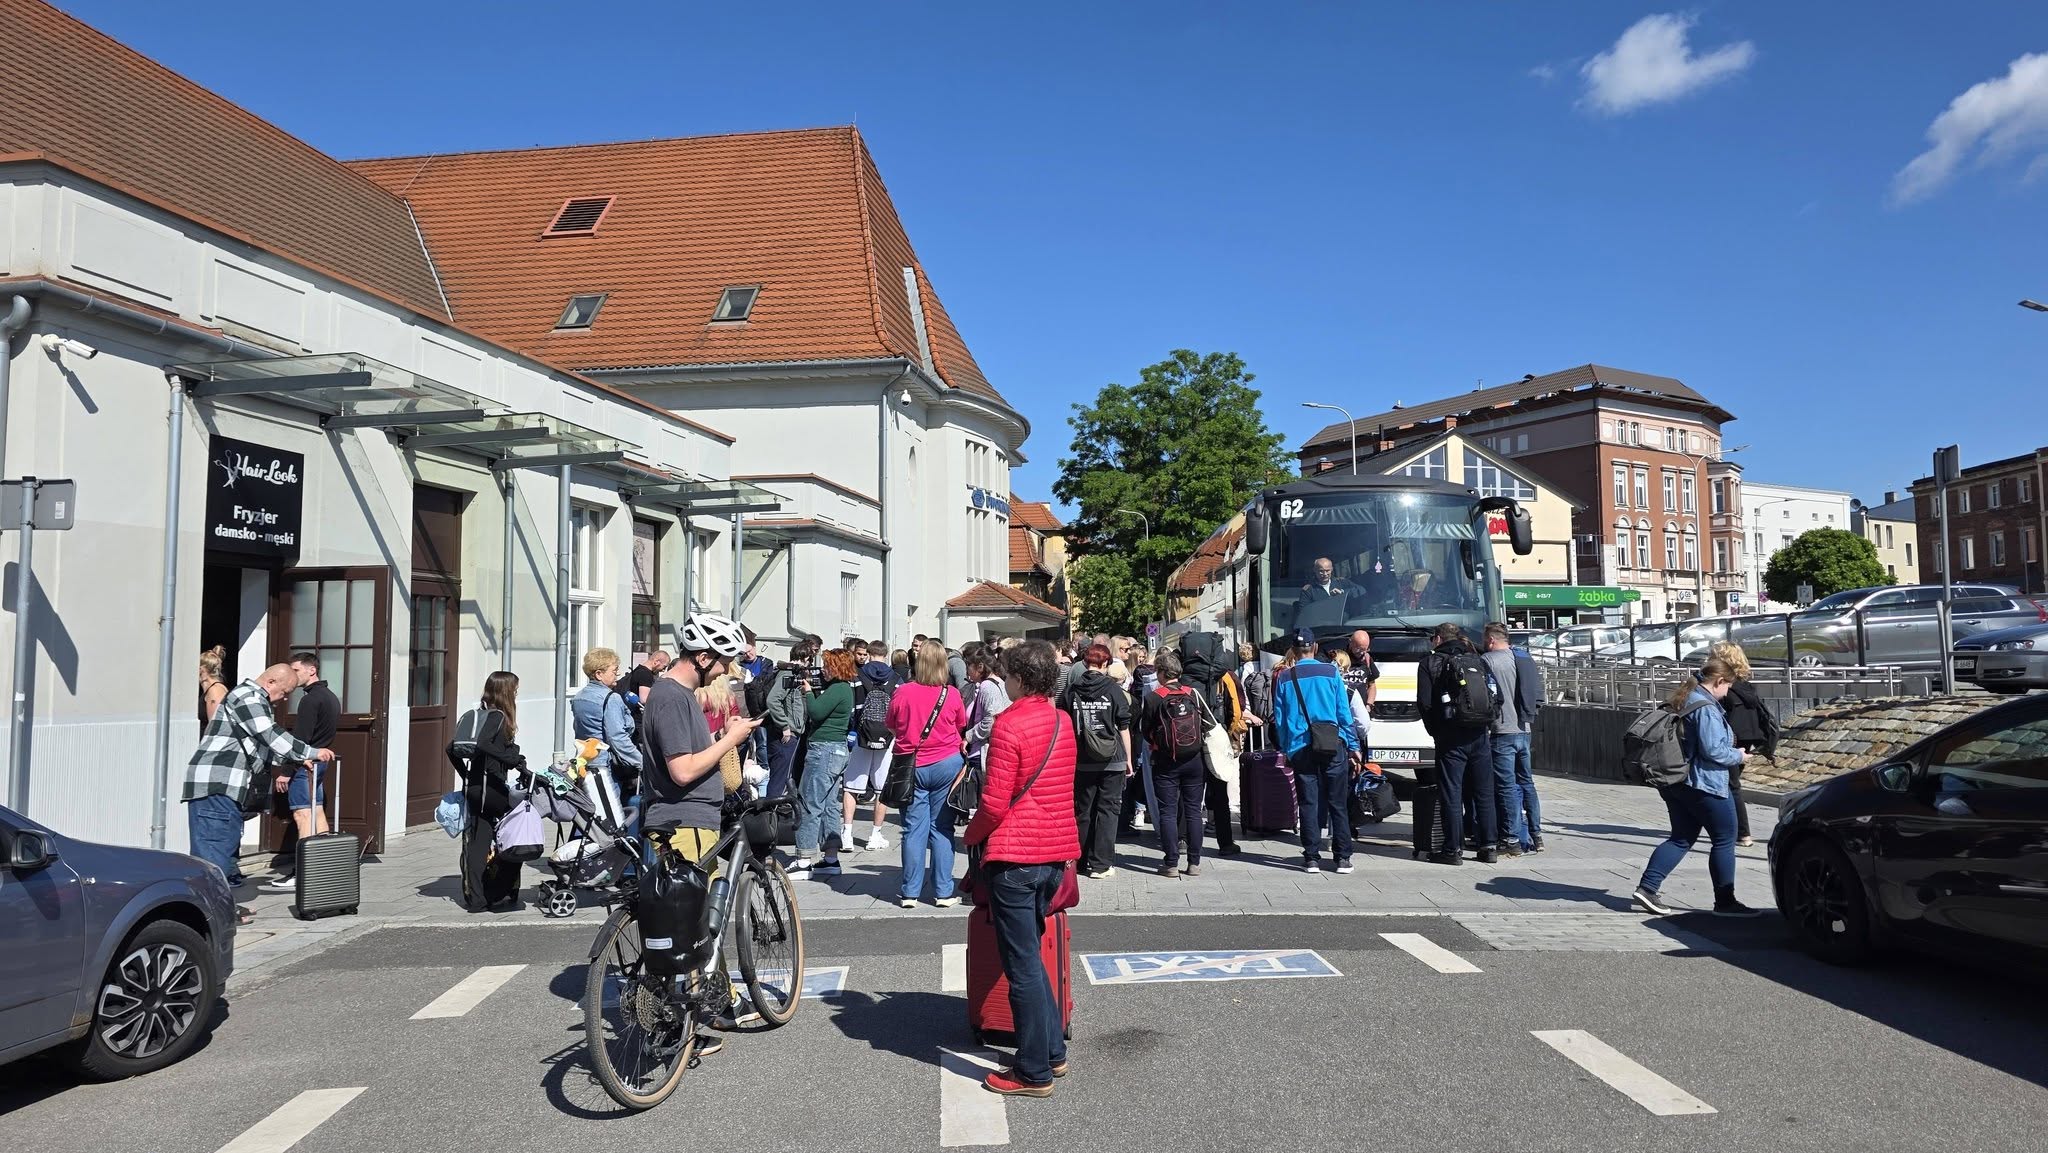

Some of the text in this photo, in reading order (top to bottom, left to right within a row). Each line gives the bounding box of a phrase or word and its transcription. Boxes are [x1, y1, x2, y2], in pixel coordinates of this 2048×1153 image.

[233, 505, 278, 525] Fryzjer
[1280, 499, 1304, 518] 62
[215, 523, 256, 540] damsko
[264, 532, 294, 546] męski
[1578, 590, 1616, 602] żabka
[1374, 750, 1417, 760] OP 0947X
[1114, 956, 1308, 977] TAXI
